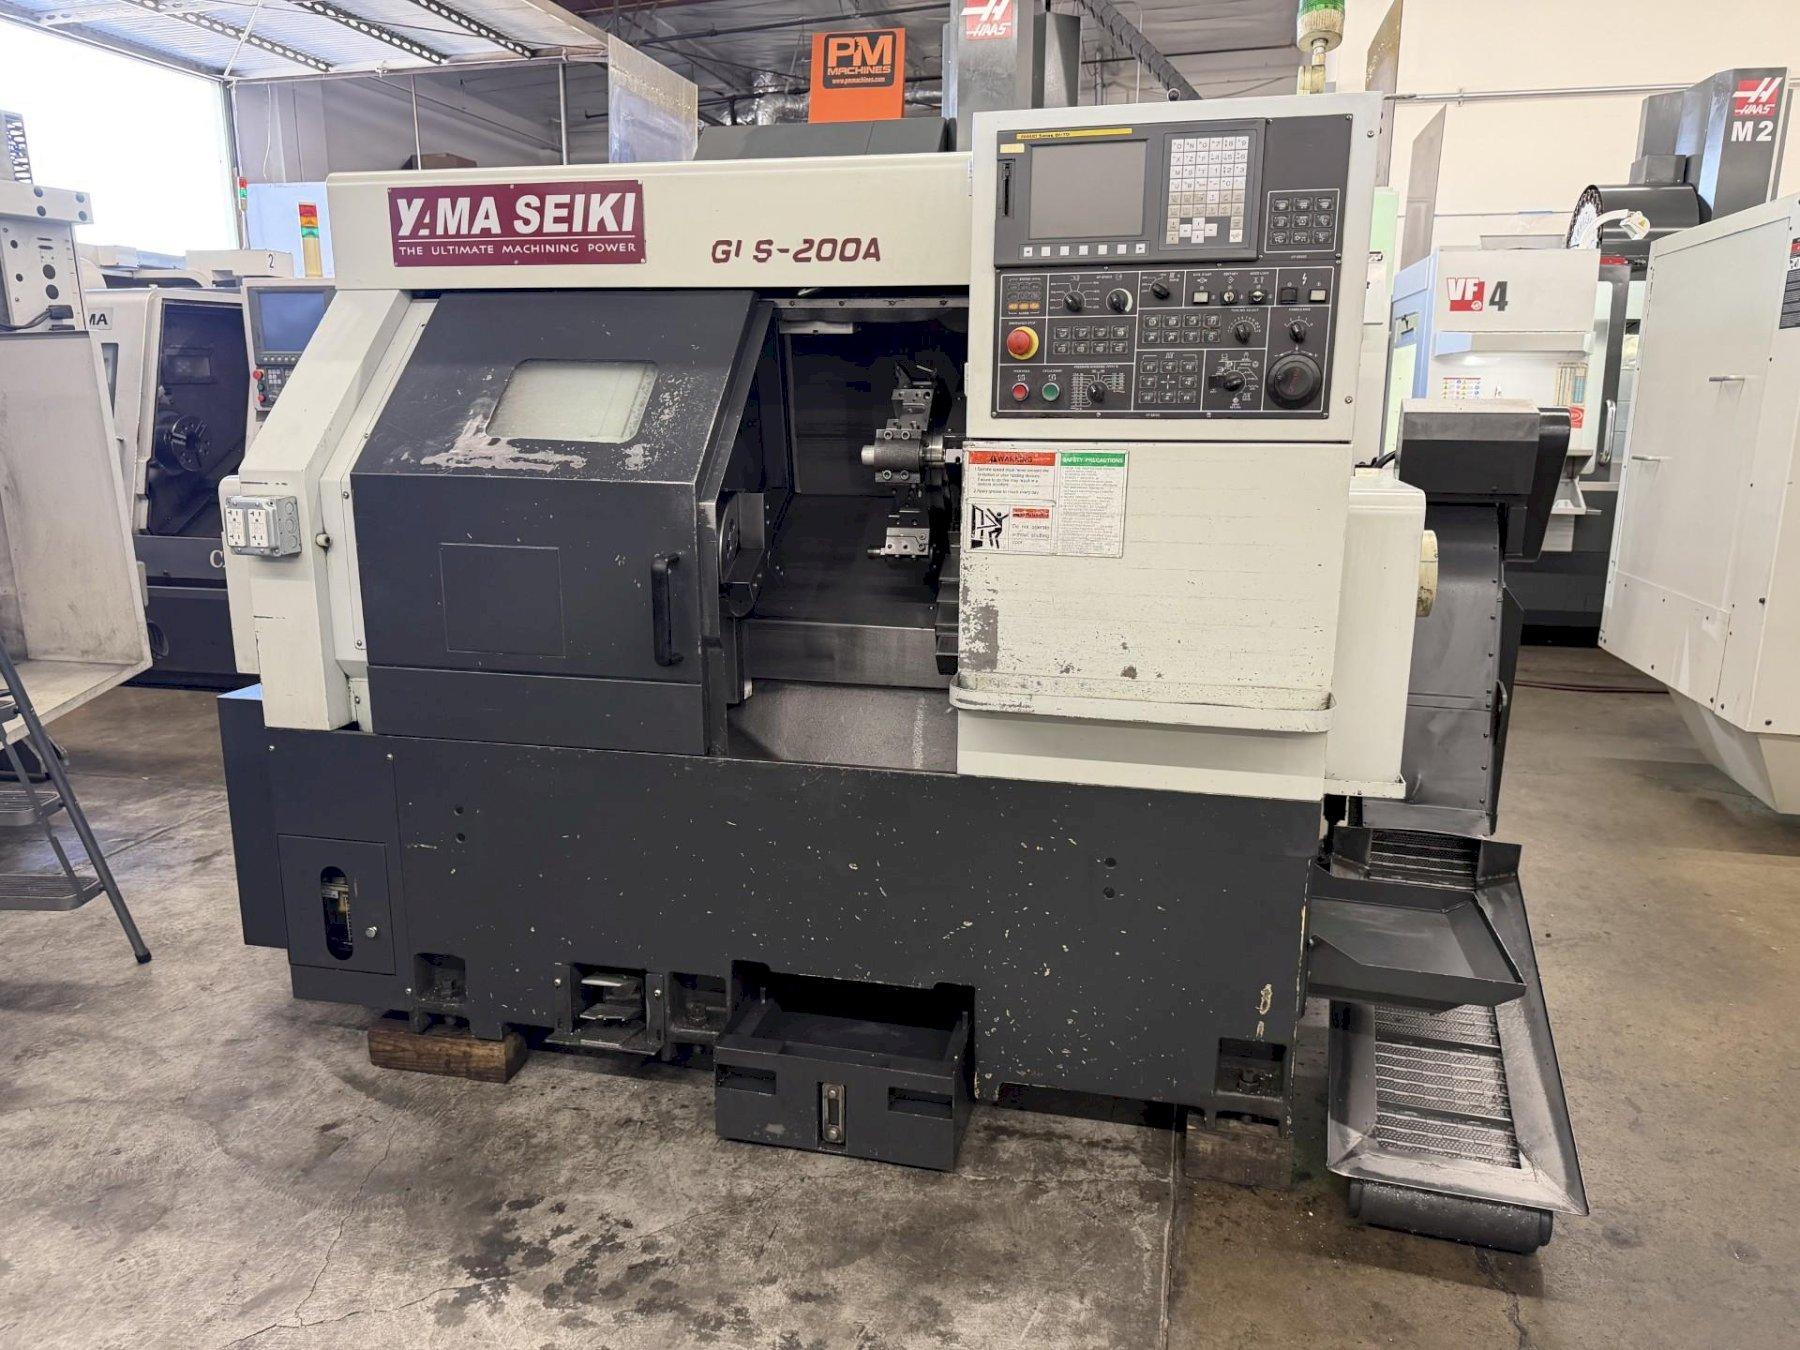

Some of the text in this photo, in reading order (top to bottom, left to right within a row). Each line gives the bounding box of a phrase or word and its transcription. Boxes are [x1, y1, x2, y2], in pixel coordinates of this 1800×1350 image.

[966, 22, 1011, 37] HAAS
[827, 34, 893, 67] PM
[827, 65, 892, 76] MACHINES
[1734, 103, 1776, 116] HAAS
[396, 192, 636, 236] YAMA SEIKI
[399, 242, 636, 256] THE ULTIMATE MACHINING POWER
[268, 253, 275, 269] 2
[1488, 281, 1509, 312] 4
